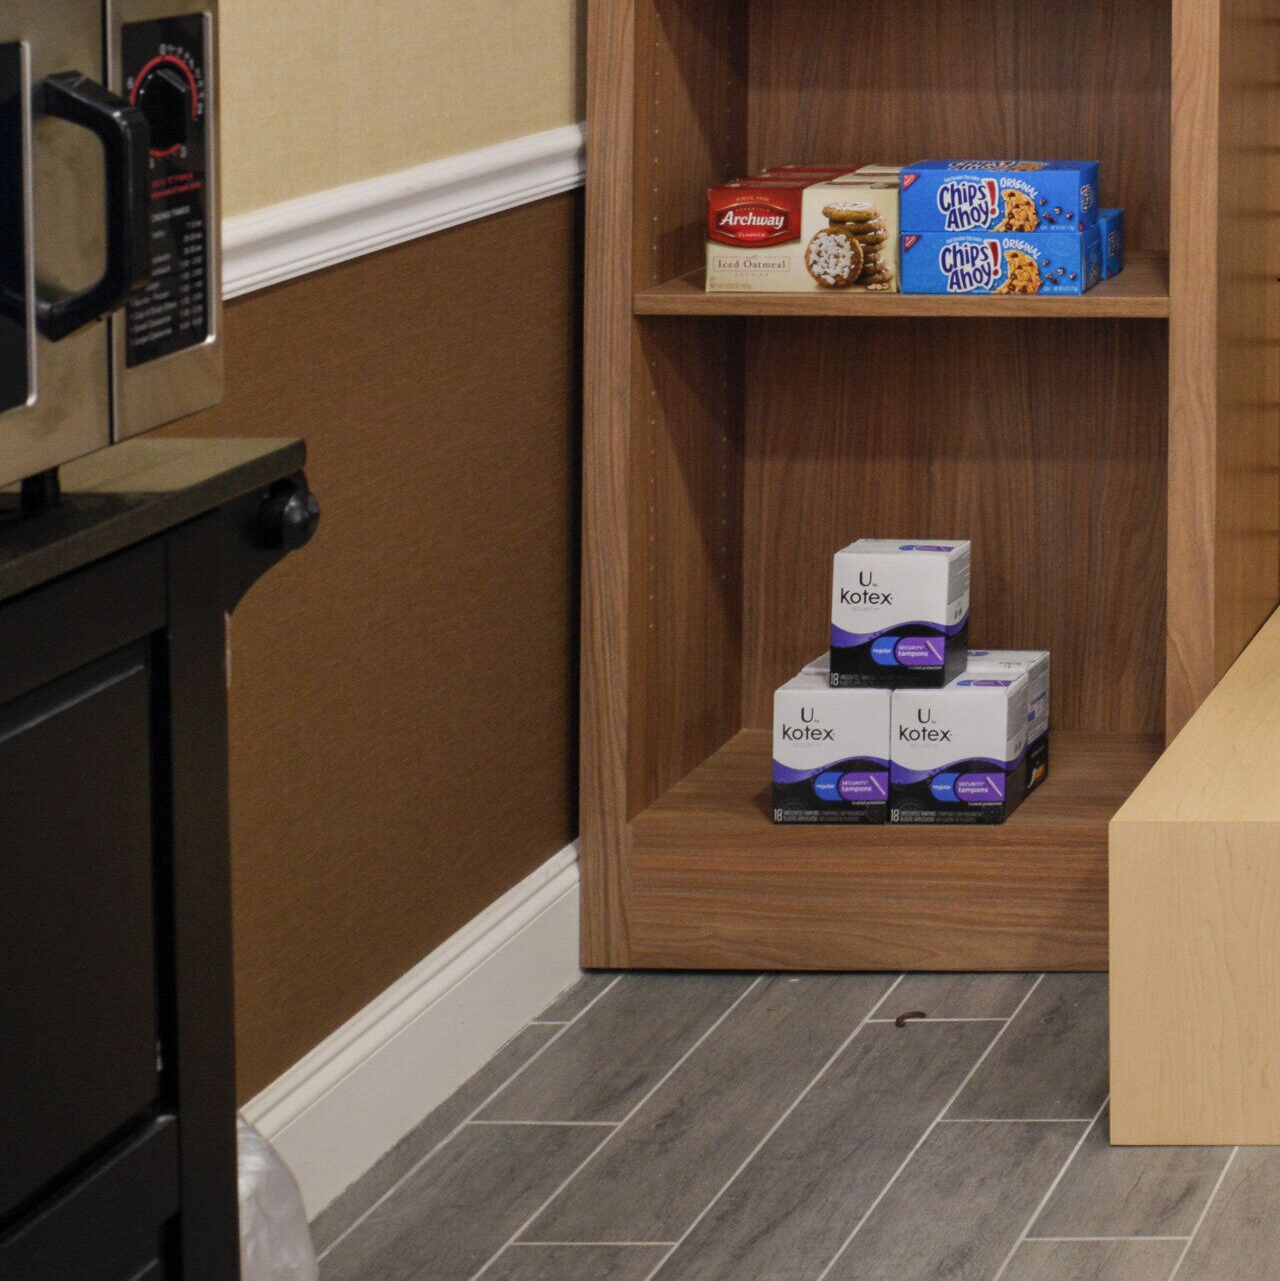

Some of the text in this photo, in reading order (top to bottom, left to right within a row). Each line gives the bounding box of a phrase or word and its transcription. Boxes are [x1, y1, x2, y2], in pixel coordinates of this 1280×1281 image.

[939, 180, 986, 213] Chips
[1000, 177, 1038, 200] ORIGINAL
[719, 211, 785, 229] Archway
[1002, 238, 1041, 260] ORIGINAL
[718, 259, 786, 269] Iced Oatmeal
[941, 241, 989, 274] Chips
[859, 571, 872, 587] U
[830, 673, 839, 686] 18
[801, 707, 814, 723] U
[917, 708, 931, 724] U
[774, 808, 783, 821] 18
[891, 808, 899, 822] 18
